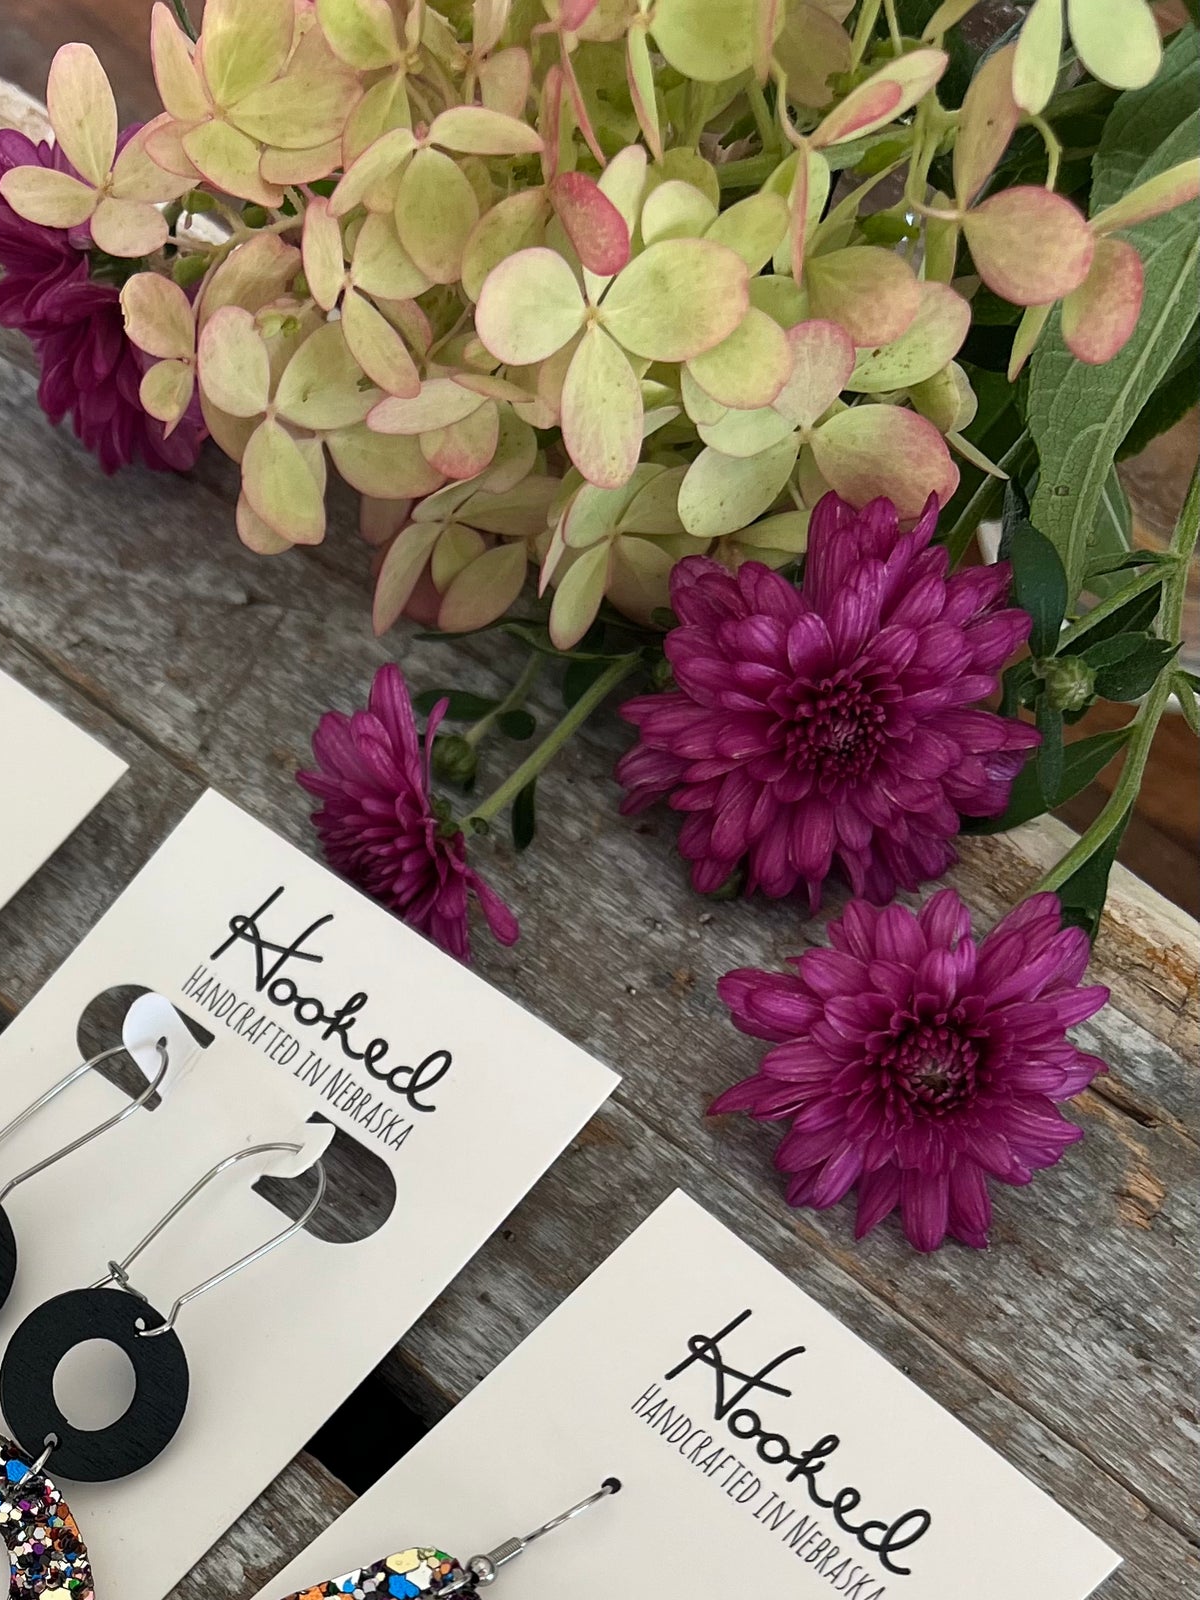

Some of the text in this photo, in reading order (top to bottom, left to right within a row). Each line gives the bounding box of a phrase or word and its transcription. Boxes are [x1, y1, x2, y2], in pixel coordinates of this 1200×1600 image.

[181, 964, 300, 1065] HANDCRAFTED
[293, 1050, 331, 1088] IN
[210, 886, 452, 1112] Hooked
[630, 1383, 762, 1504] HANDCRAFTED
[752, 1491, 796, 1531] IN
[664, 1309, 931, 1575] Hooked
